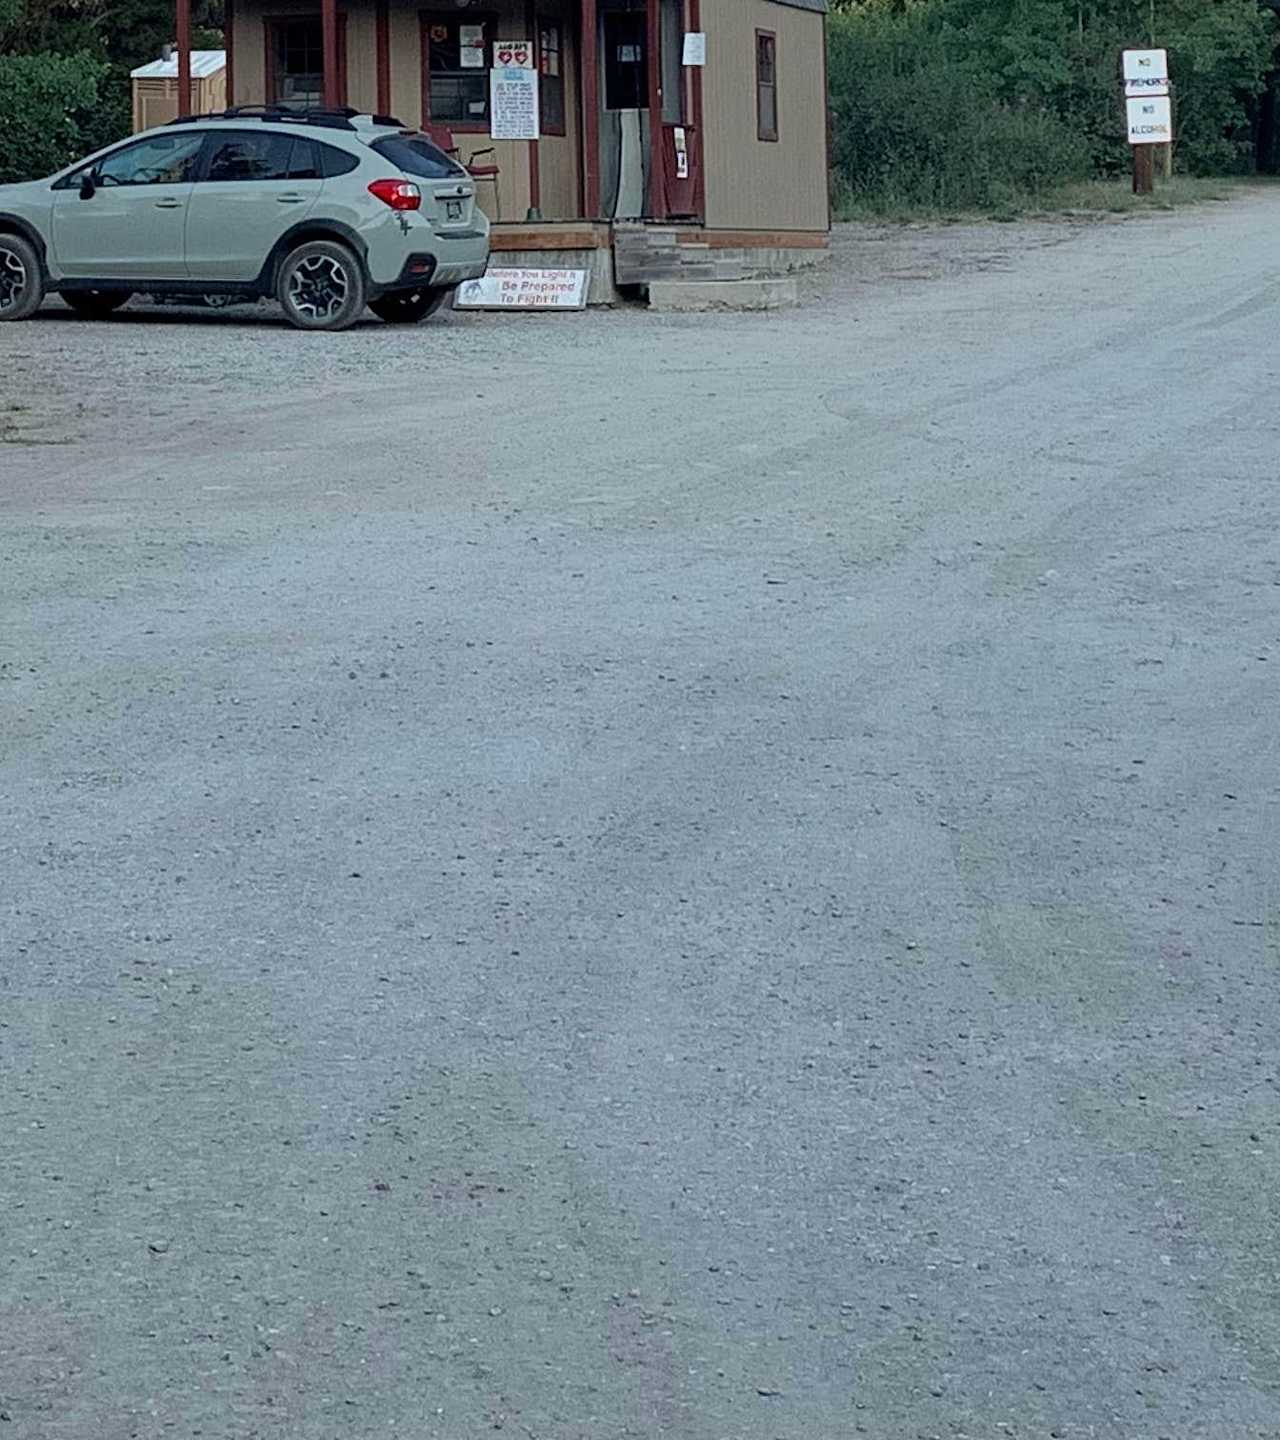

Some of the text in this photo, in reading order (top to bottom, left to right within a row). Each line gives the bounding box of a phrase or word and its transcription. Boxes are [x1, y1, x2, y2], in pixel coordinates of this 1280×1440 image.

[1142, 105, 1154, 114] NO
[1131, 125, 1168, 134] ALCOHOL
[502, 281, 576, 292] Be Prepared
[502, 293, 514, 303] To
[518, 294, 548, 304] Fight
